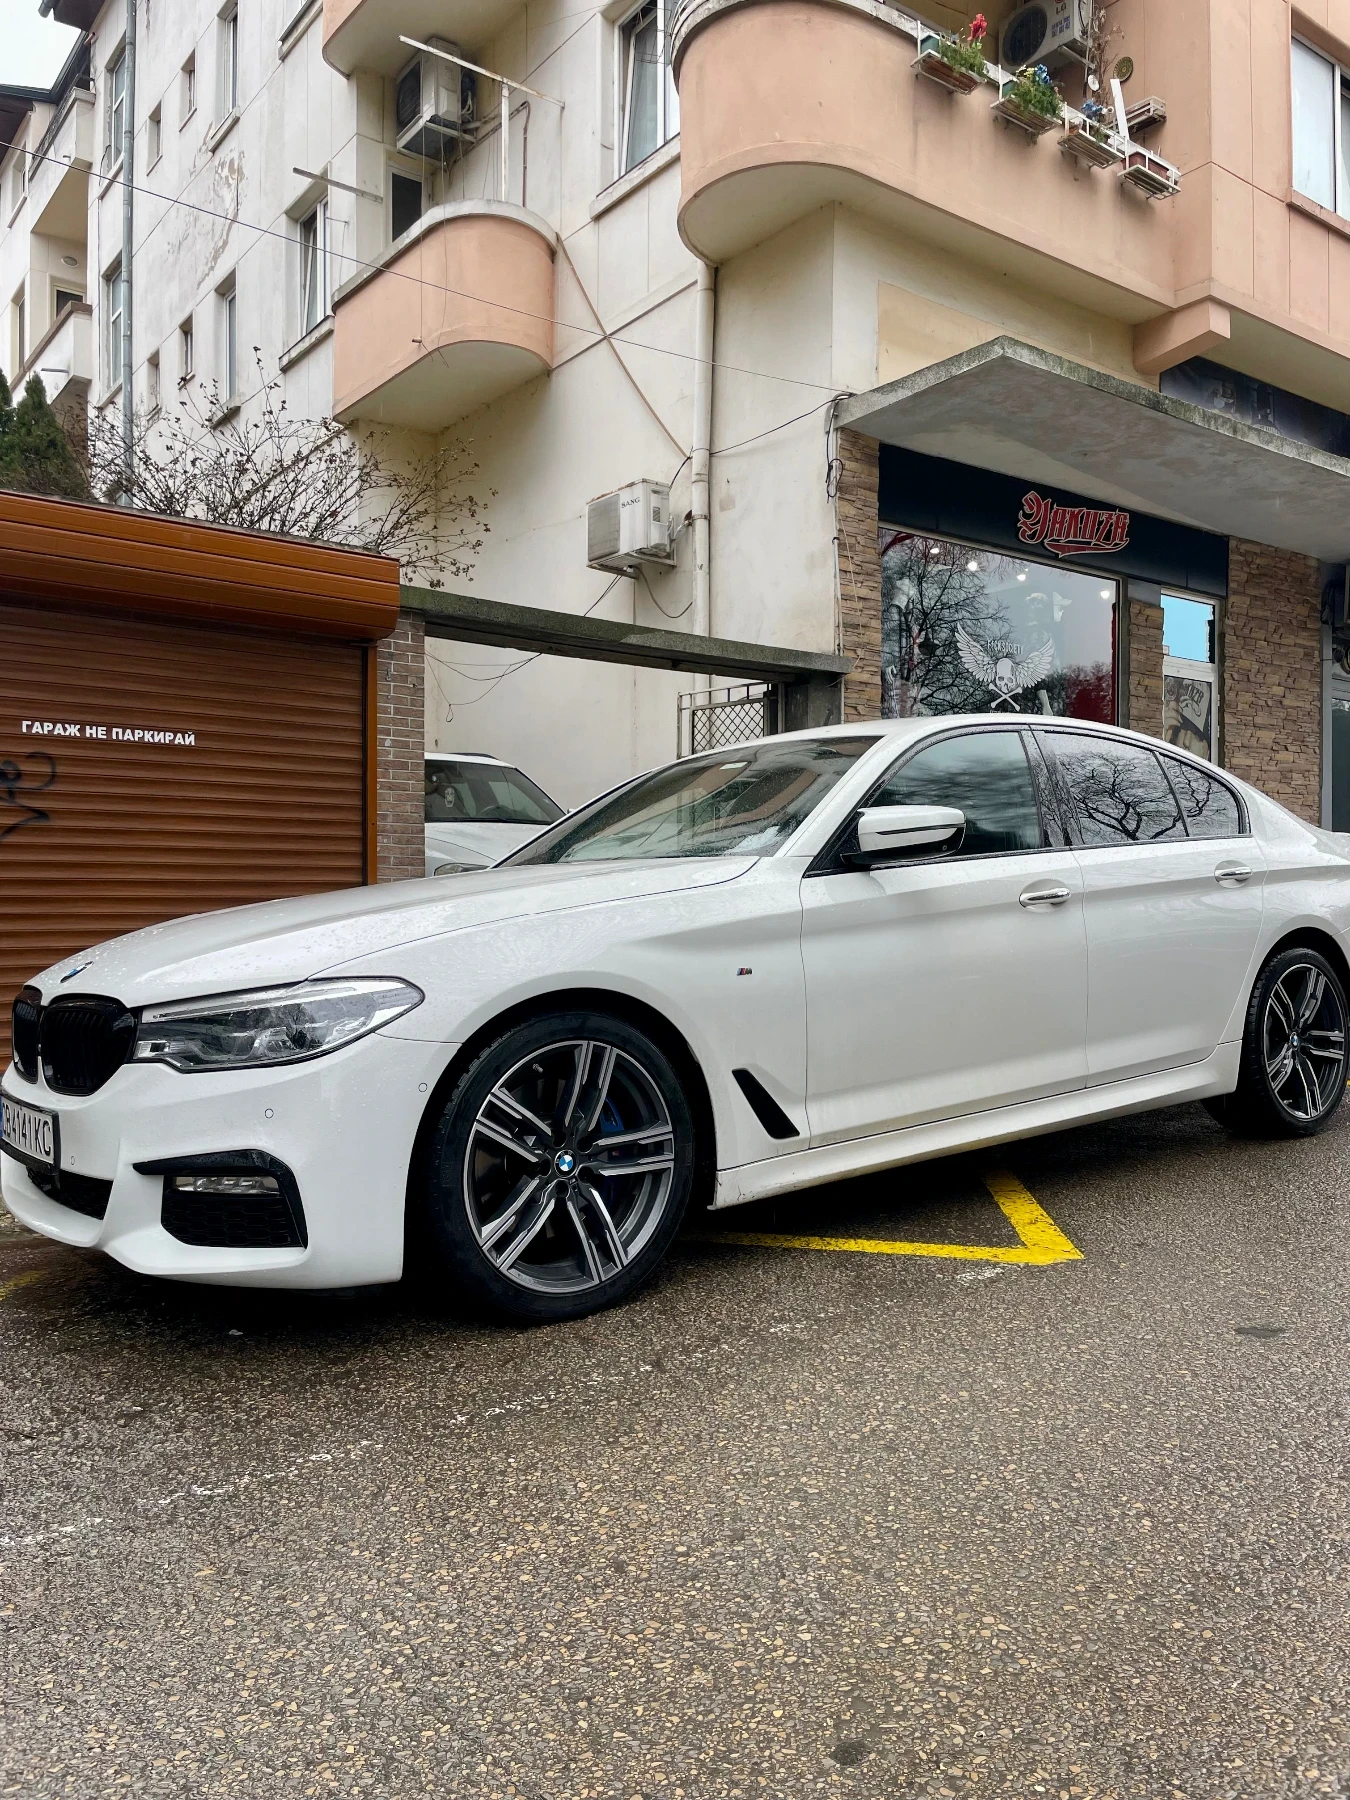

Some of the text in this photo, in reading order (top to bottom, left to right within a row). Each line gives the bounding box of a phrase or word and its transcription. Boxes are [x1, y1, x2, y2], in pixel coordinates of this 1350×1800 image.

[22, 720, 196, 746] ГАРАЖ НЕ ПАРКИРАЙ
